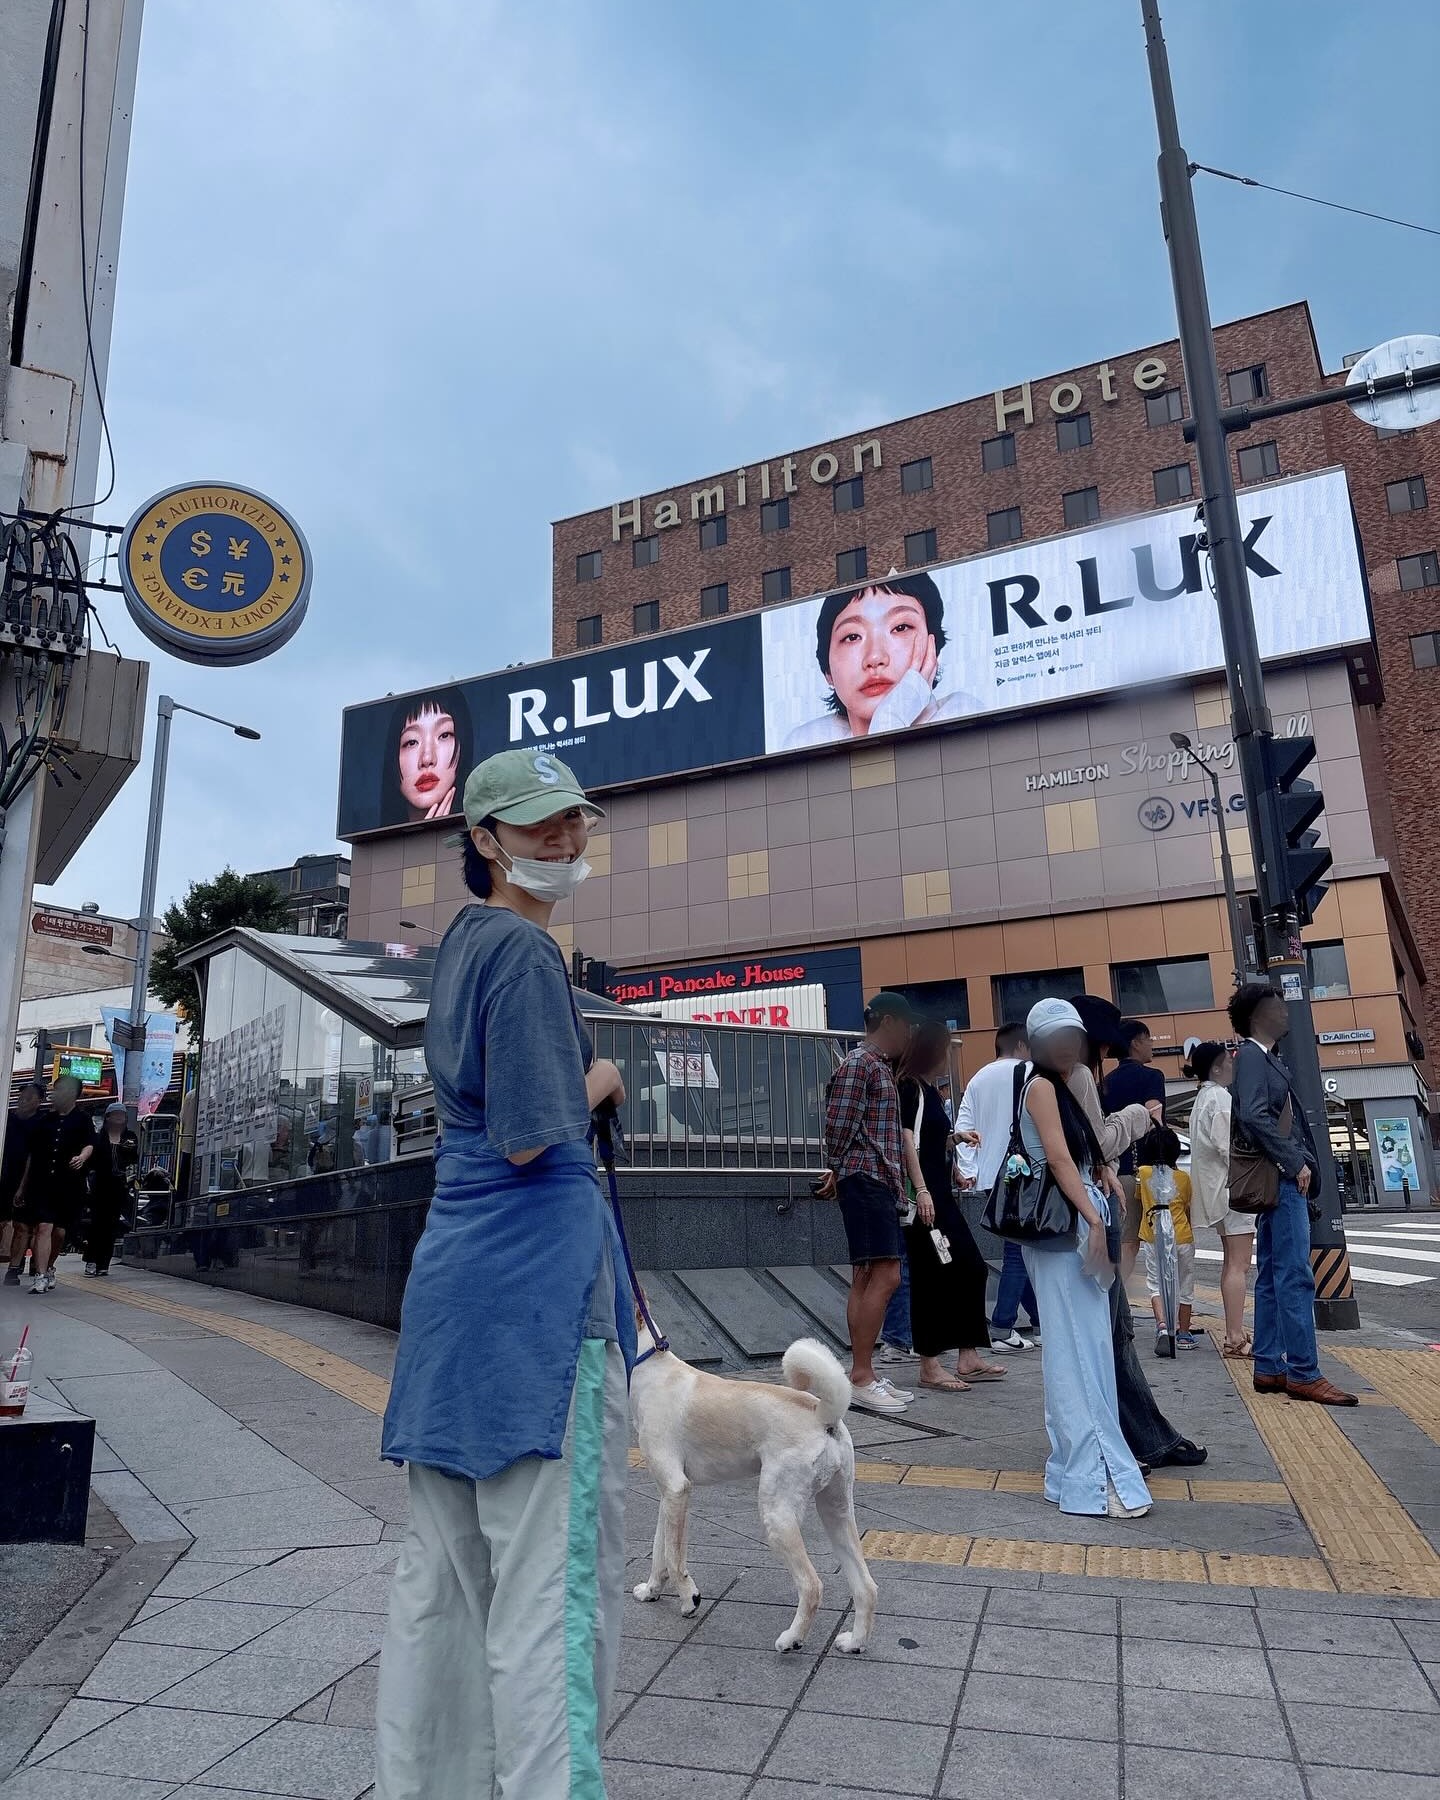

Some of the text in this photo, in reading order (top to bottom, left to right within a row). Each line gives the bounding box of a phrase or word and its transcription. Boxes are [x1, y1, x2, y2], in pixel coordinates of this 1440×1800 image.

[612, 357, 1167, 541] Hamilton Hote
[169, 496, 278, 534] AUTHORIZED
[142, 571, 283, 629] MONEY EXCHANGE
[1011, 641, 1033, 652] 편하게
[1035, 636, 1058, 647] 만나는
[1086, 625, 1101, 636] 뷰티
[995, 659, 1010, 668] 지금
[1007, 674, 1024, 683] Google
[507, 648, 712, 742] R.LUX
[534, 756, 559, 784] S
[1025, 764, 1109, 792] HAMILTON
[1119, 741, 1237, 782] Shopping
[1180, 794, 1246, 818] VFS.G
[660, 970, 735, 998] Pancake
[740, 965, 805, 987] House
